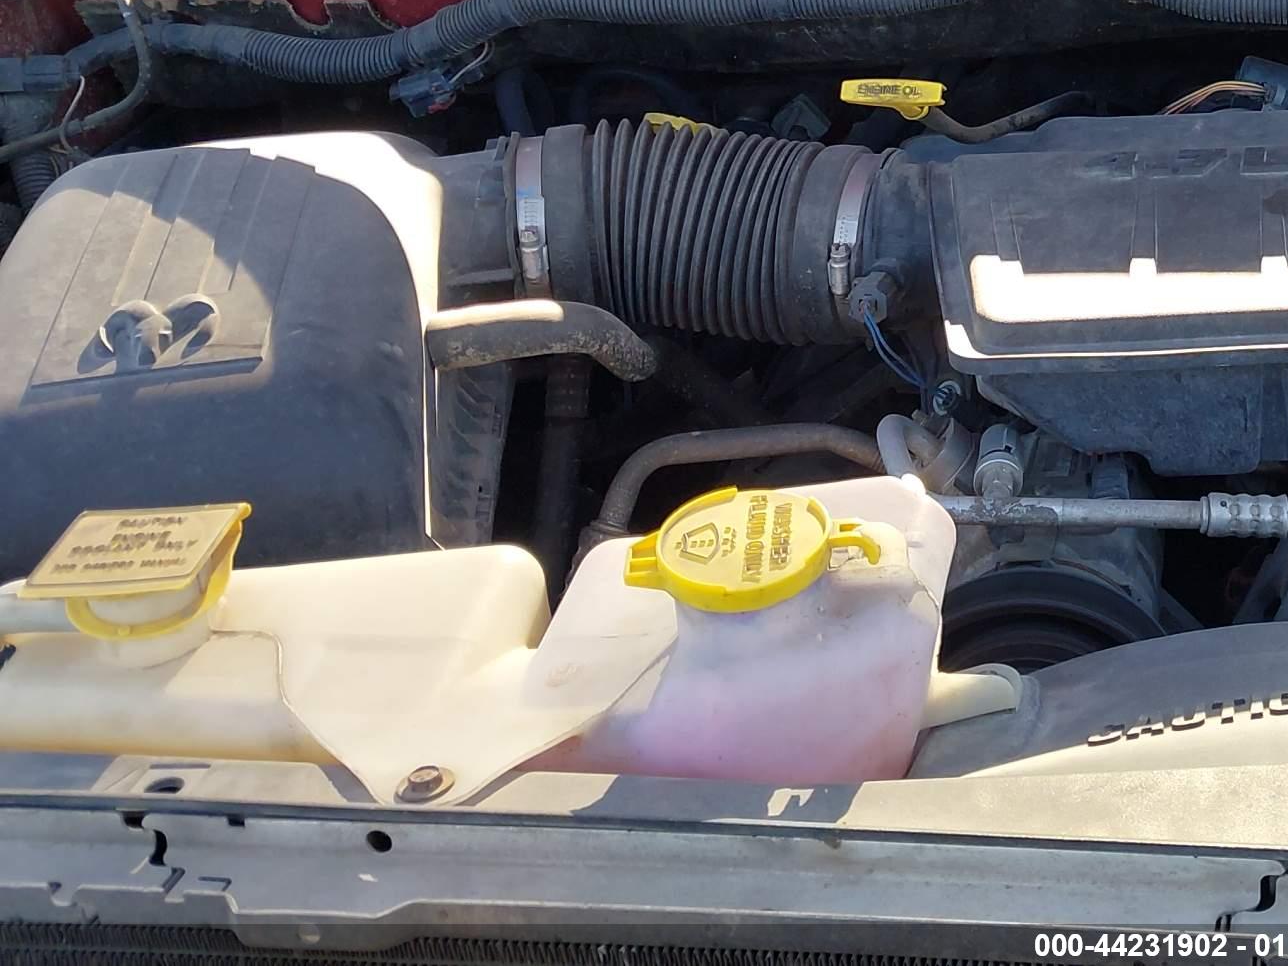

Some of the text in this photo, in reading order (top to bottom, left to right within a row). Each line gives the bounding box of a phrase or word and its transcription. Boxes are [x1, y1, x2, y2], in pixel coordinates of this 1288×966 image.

[743, 495, 768, 583] FLUID ONLY
[769, 502, 793, 572] WASHER
